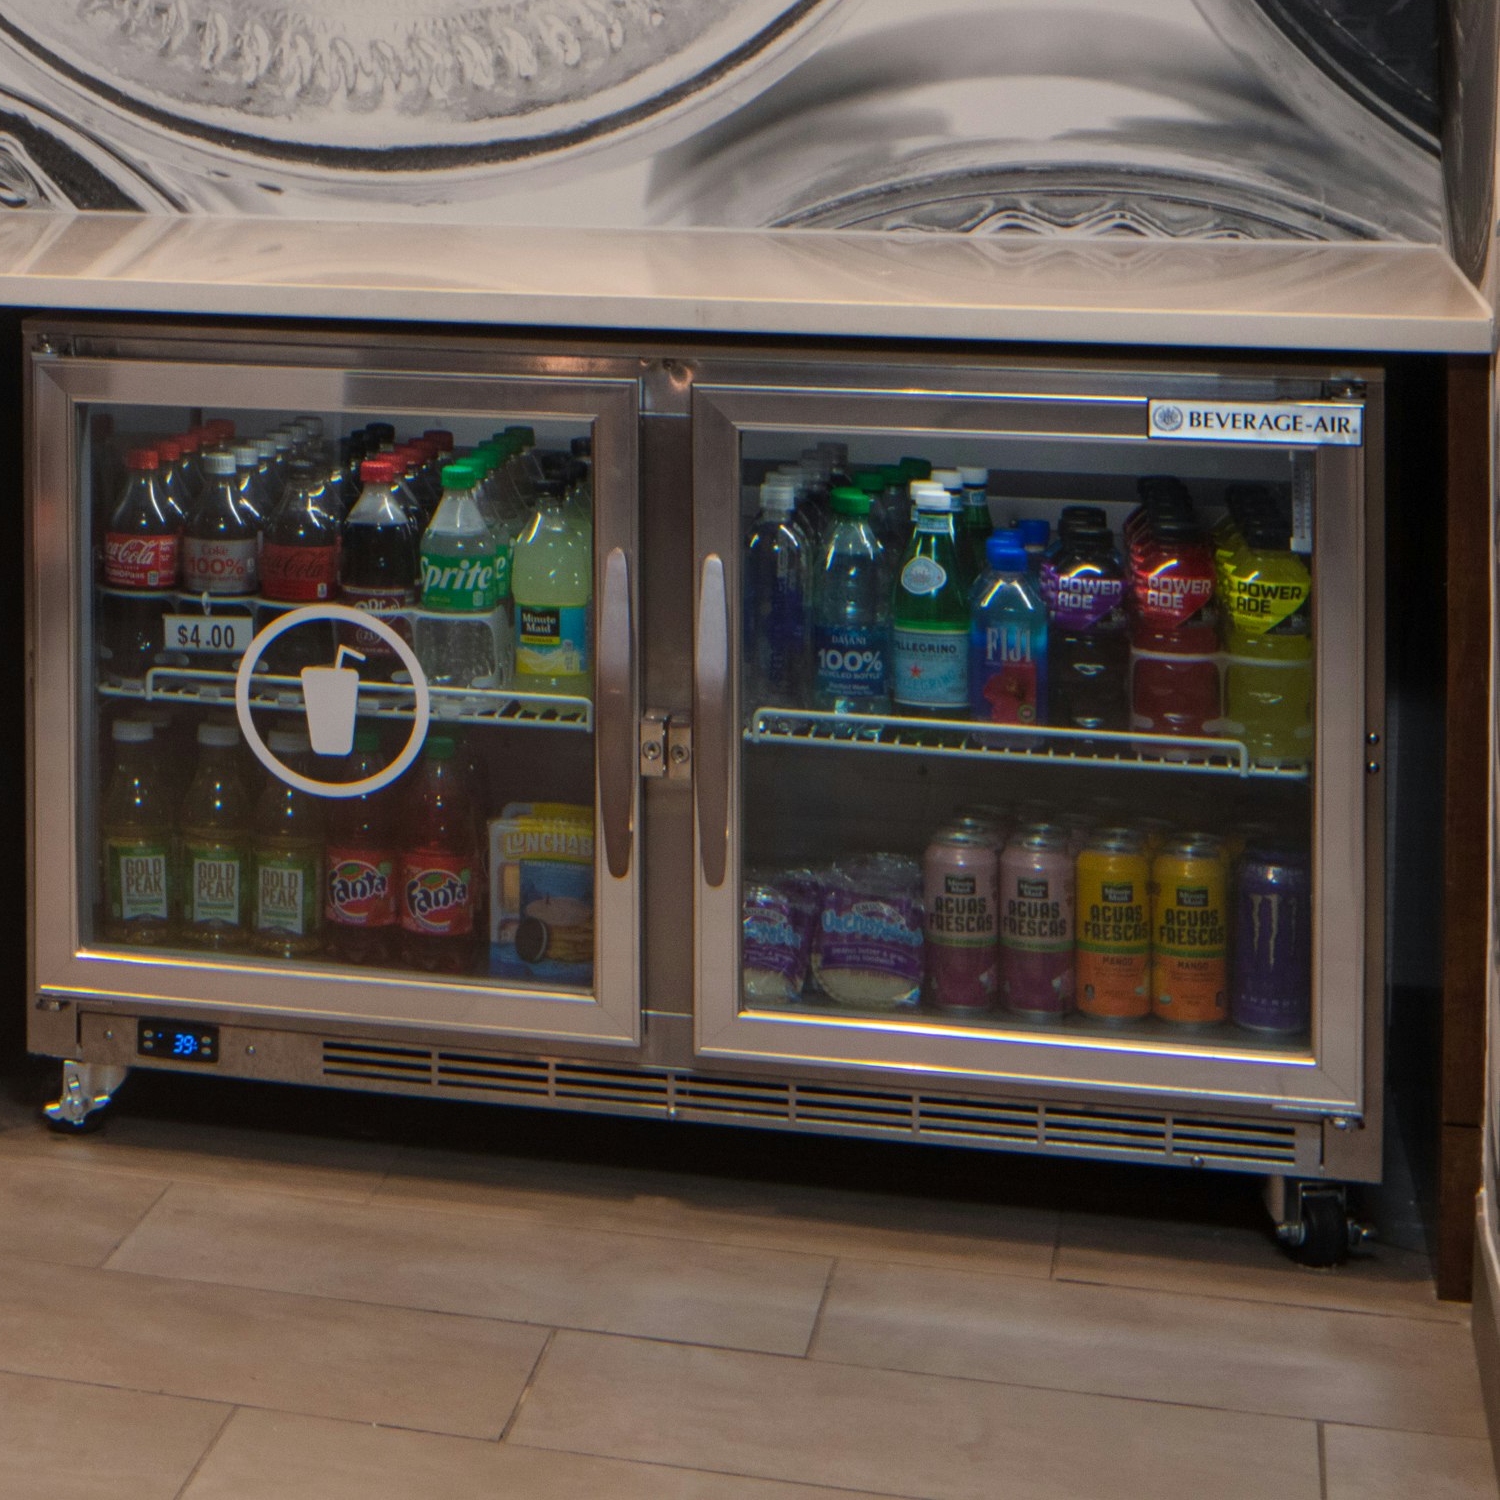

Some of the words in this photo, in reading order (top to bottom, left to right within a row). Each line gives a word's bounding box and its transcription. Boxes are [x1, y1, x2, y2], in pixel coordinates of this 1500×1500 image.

[1188, 410, 1353, 436] BEVERAGE-AIR
[188, 557, 245, 576] 100%
[419, 556, 493, 593] Sprite
[1058, 576, 1122, 596] POWER
[1147, 576, 1211, 596] POWER
[1237, 581, 1301, 601] POWER
[1058, 591, 1094, 609] ADE
[1147, 591, 1183, 609] ADE
[1237, 596, 1273, 614] ADE
[521, 612, 557, 625] Minute
[526, 623, 552, 634] Maid
[177, 623, 235, 650] $4.00
[986, 627, 1032, 663] FIJI
[817, 649, 884, 671] 100%
[125, 860, 160, 879] GOLD
[200, 863, 236, 883] GOLD
[263, 870, 299, 889] GOLD
[125, 877, 163, 895] PEAK
[199, 881, 234, 901] PEAK
[328, 861, 389, 903] Fanta
[261, 887, 298, 907] PEAK
[406, 871, 469, 916] Fanta
[929, 913, 994, 934] FRESCAS
[1003, 917, 1067, 938] FRESCAS
[1083, 921, 1149, 942] FRESCAS
[1158, 925, 1226, 946] FRESCAS
